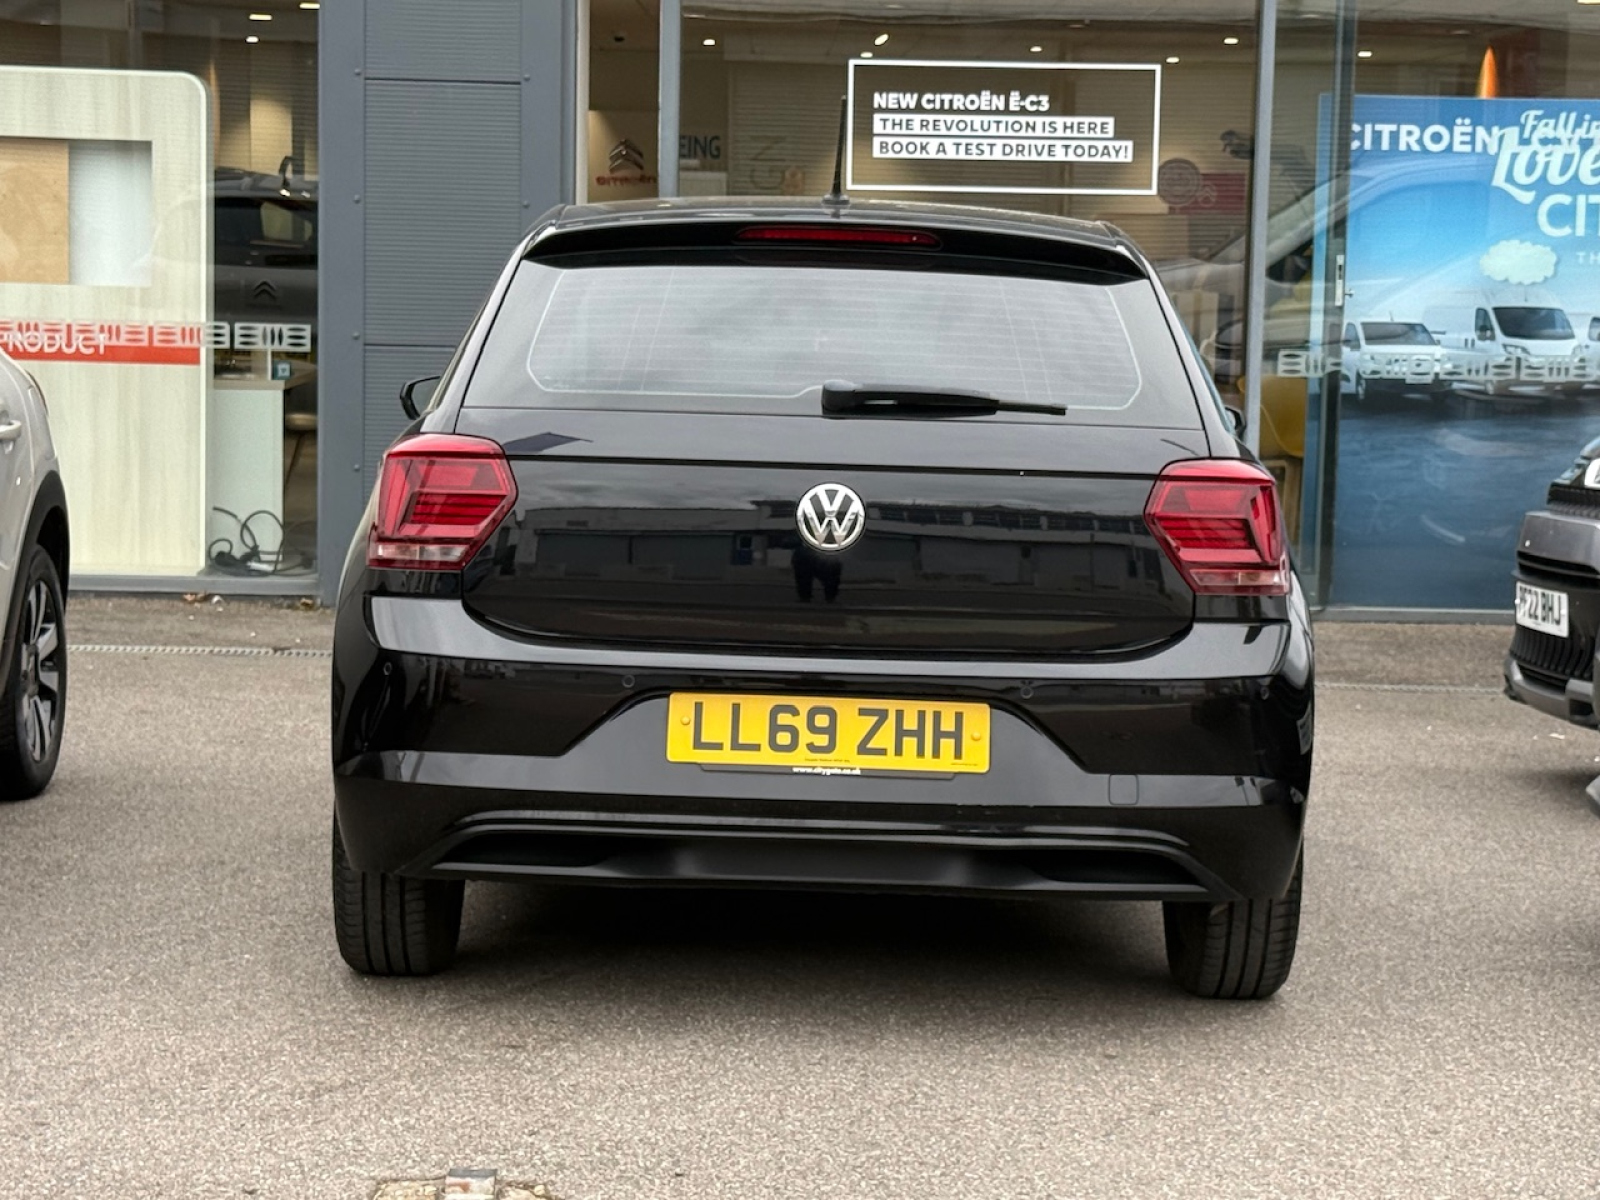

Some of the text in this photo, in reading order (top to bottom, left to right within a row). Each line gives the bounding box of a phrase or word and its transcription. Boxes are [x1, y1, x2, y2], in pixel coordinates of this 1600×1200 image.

[873, 90, 1050, 111] NEW CITROËN Ë-C3
[880, 118, 1110, 135] THE REVOLUTION IS HERE
[880, 140, 1130, 159] BOOK A TEST DRIVE TODAY!
[692, 701, 964, 761] LL69 ZHH
